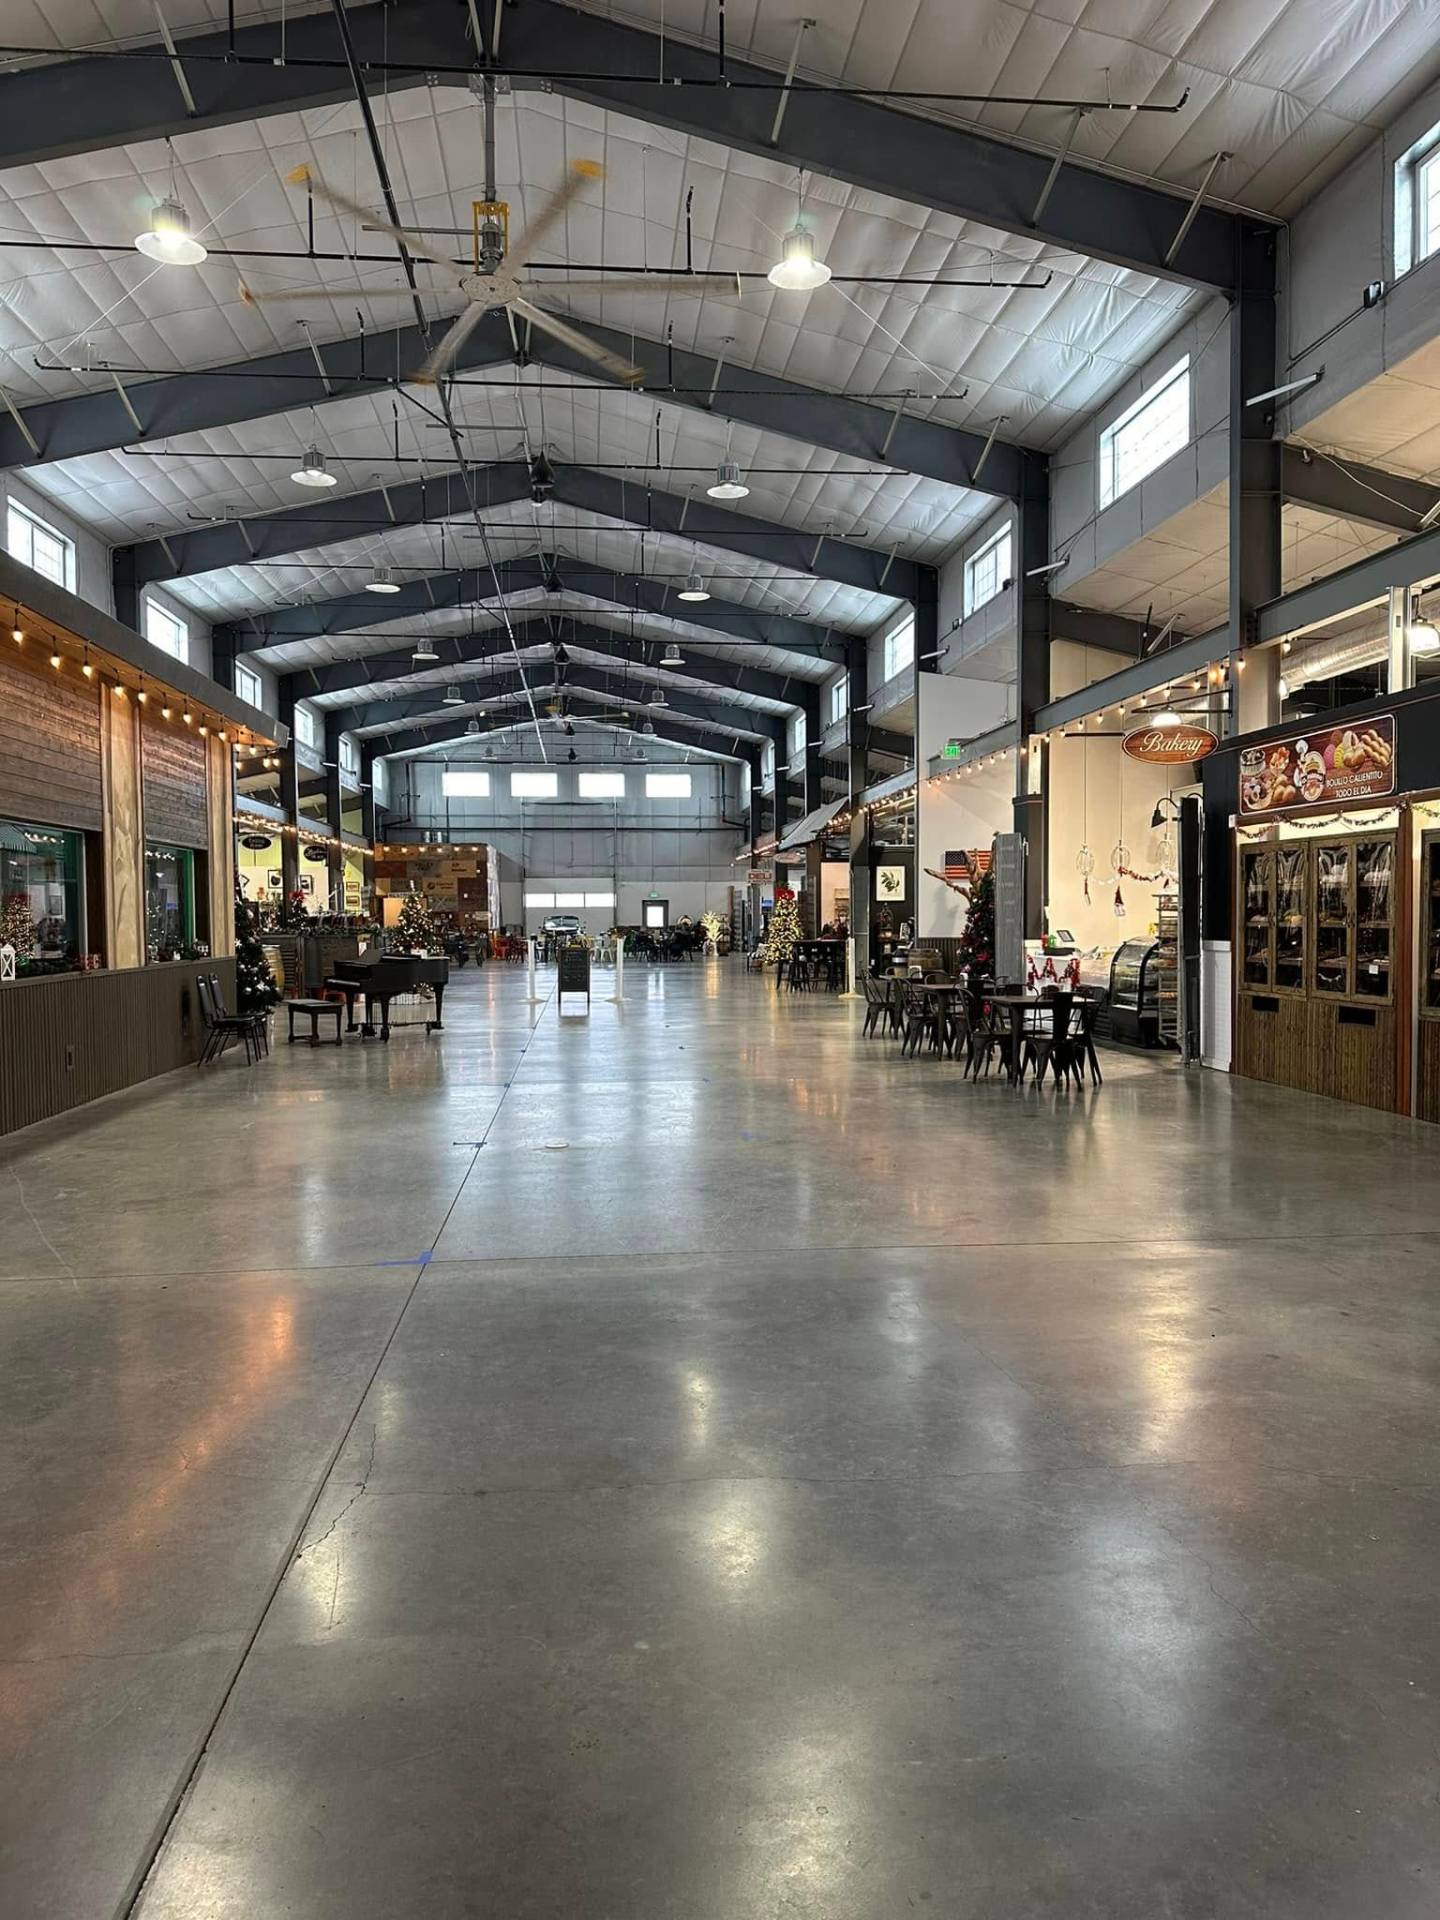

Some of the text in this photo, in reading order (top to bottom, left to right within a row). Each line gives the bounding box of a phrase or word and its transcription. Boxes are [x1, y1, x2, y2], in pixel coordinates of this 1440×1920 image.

[1140, 732, 1203, 757] Bakery
[1335, 788, 1352, 798] TODO
[1353, 786, 1360, 796] EL
